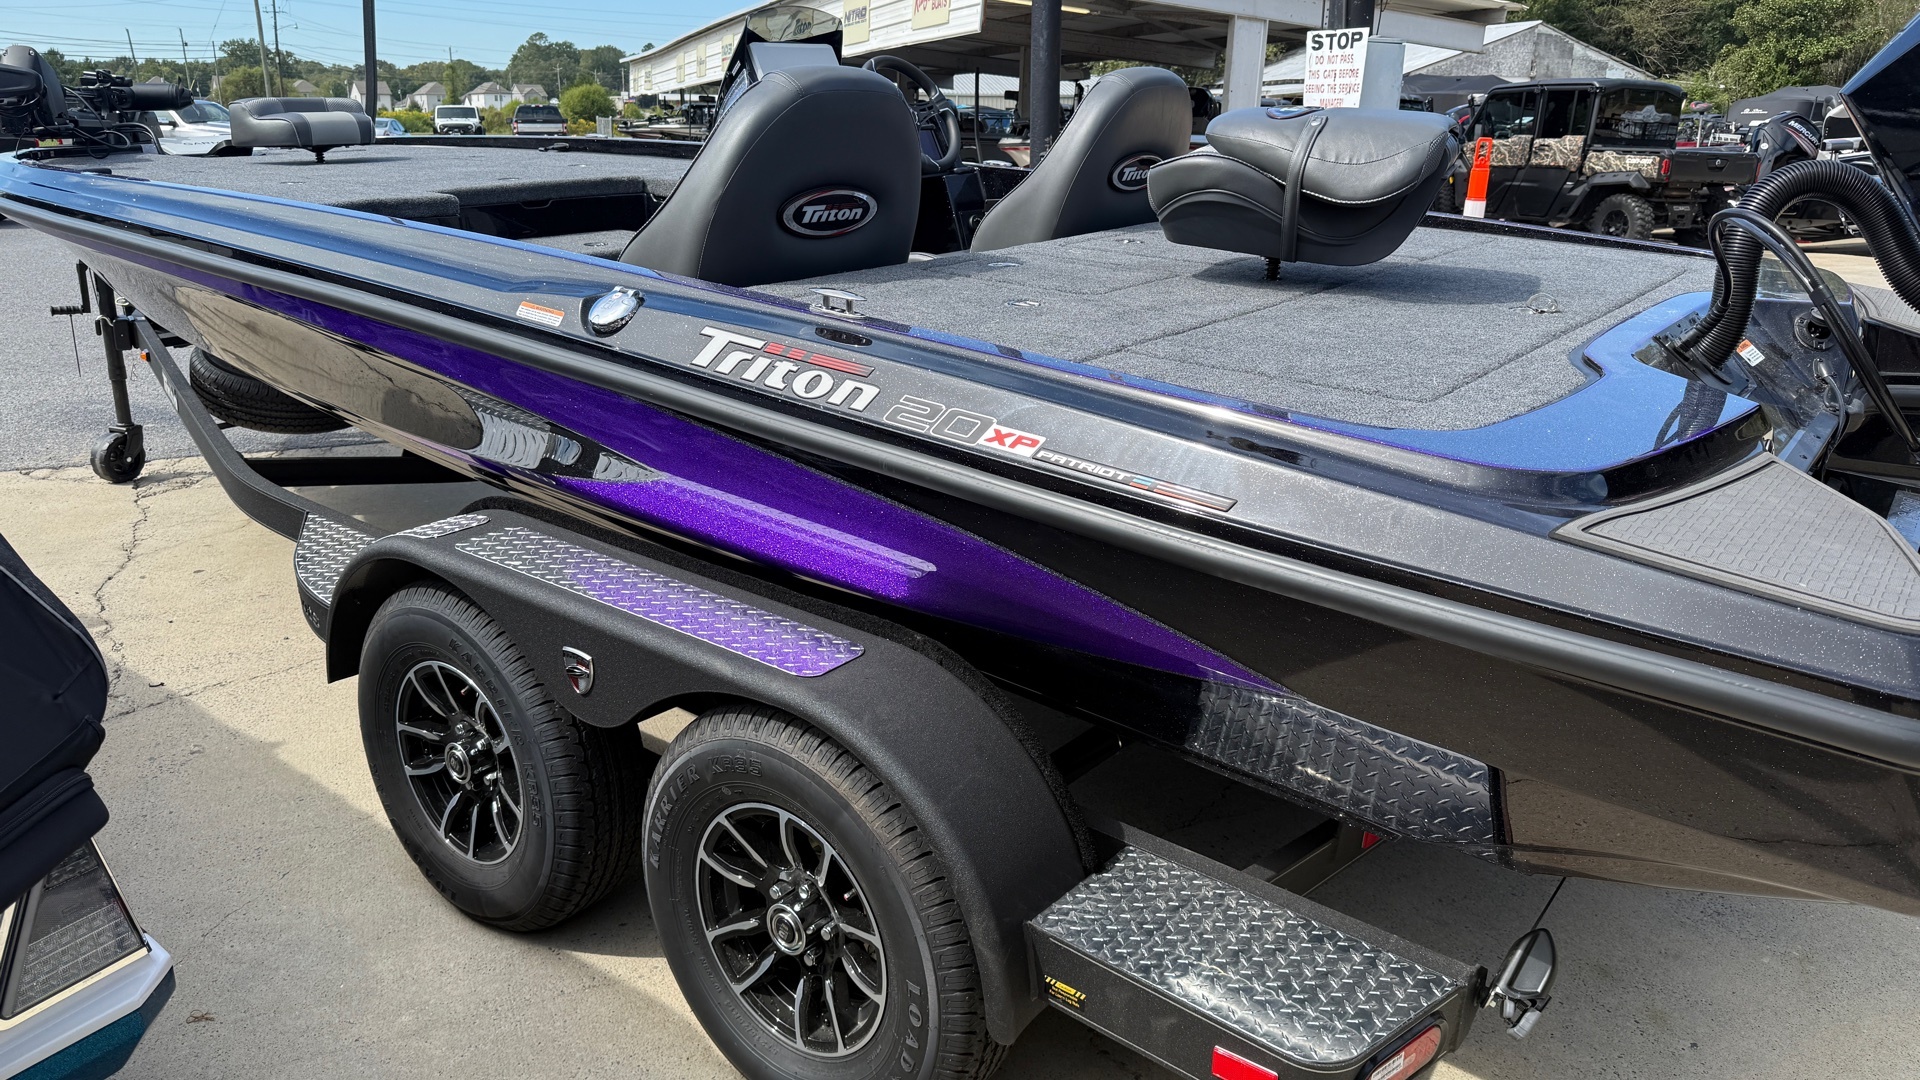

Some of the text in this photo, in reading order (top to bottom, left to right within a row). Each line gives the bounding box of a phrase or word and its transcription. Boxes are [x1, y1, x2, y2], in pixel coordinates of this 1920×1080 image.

[843, 6, 867, 24] NITRO
[1311, 31, 1364, 52] STOP
[1315, 54, 1354, 65] DO NOT PASS
[1309, 68, 1359, 80] THIS GATE BEFORE
[1305, 83, 1360, 94] SEEING THE SERVICE
[1788, 120, 1821, 146] MERCURY
[1121, 166, 1149, 182] Trito
[801, 204, 864, 225] Triton
[690, 325, 880, 412] Triton
[1034, 449, 1137, 481] PATRIOT
[448, 638, 525, 747] KARRIER
[648, 764, 702, 871] KARRIER
[900, 978, 923, 1073] LOAD
